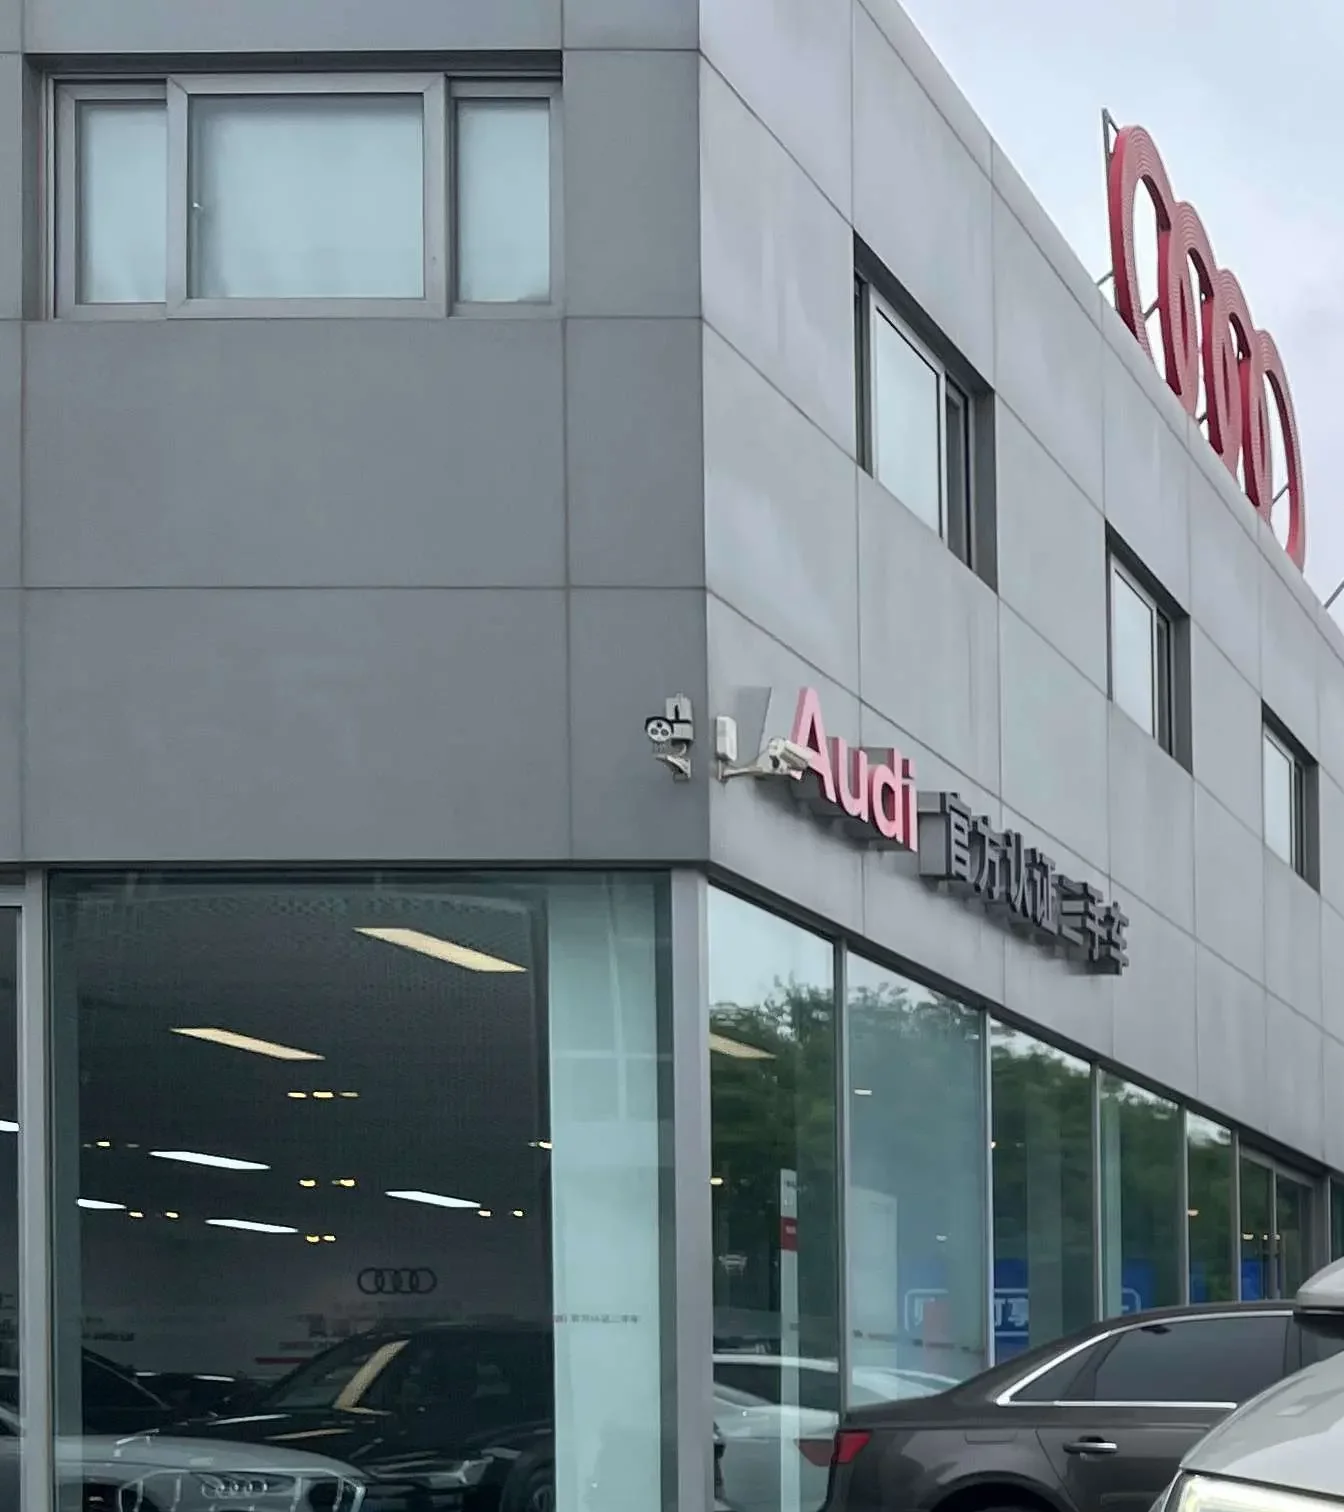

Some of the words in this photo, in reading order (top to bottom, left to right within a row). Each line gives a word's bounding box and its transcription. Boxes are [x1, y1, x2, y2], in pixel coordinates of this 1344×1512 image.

[790, 687, 918, 852] Audi
[942, 791, 1131, 976] 官方认证二手车
